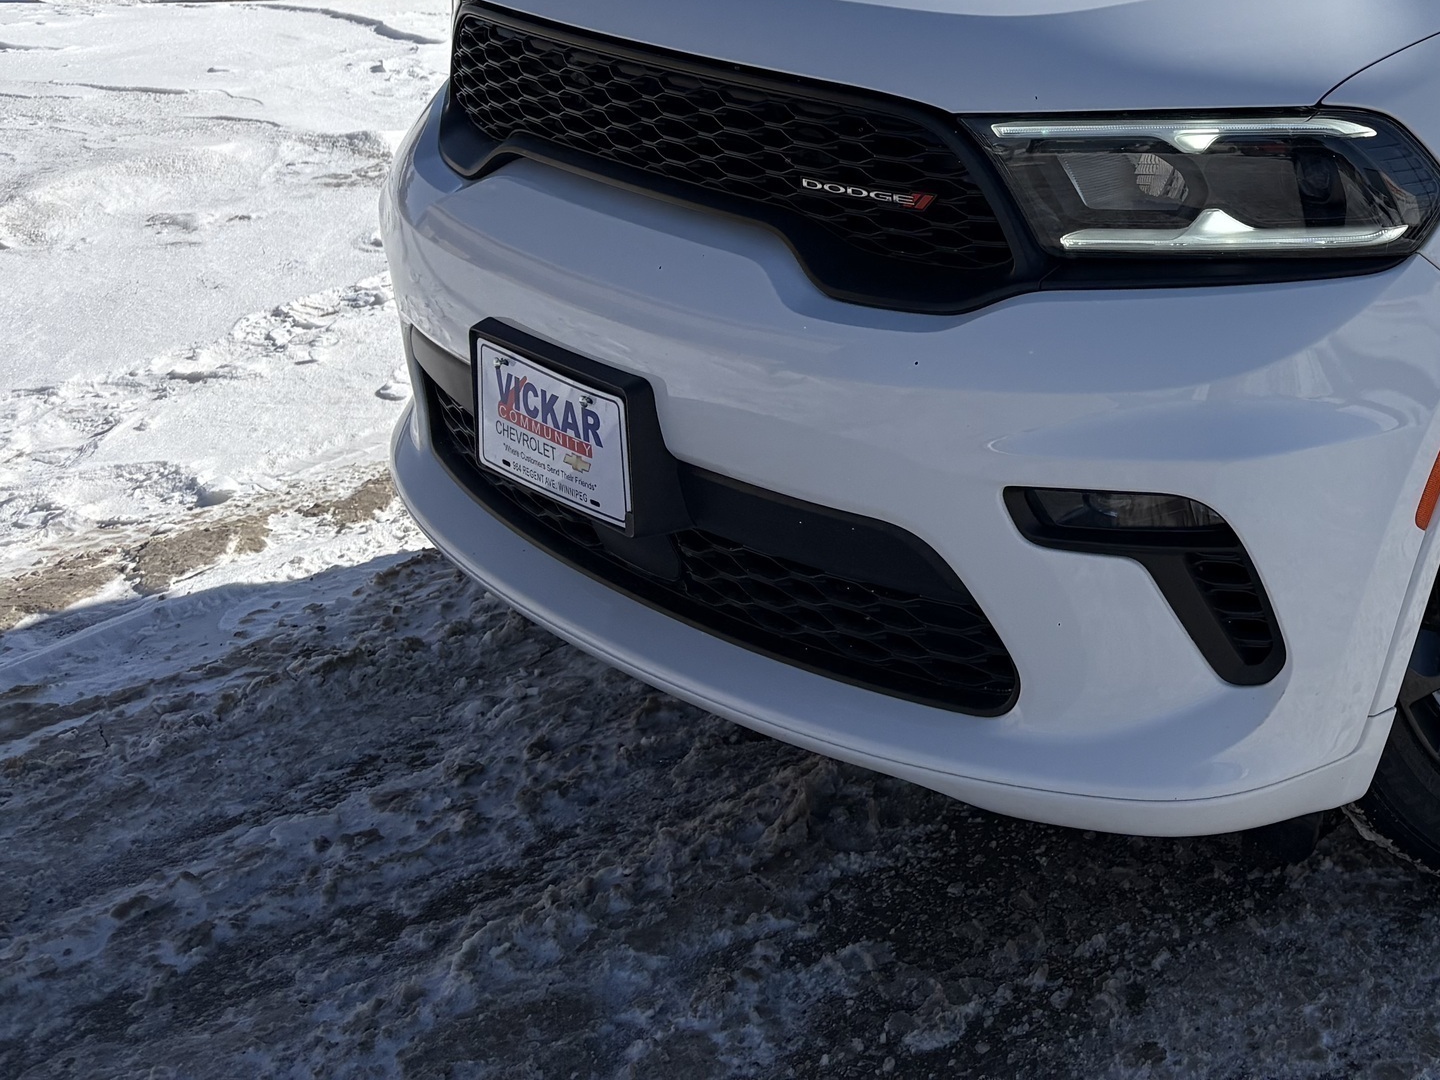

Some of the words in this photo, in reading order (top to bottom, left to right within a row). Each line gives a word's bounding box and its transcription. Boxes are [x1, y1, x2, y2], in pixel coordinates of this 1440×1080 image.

[802, 178, 915, 206] DODGE
[495, 367, 604, 449] VICKAR
[495, 419, 557, 461] CHEVROLET
[499, 405, 591, 457] COMMUNITY
[522, 465, 544, 484] REGENT
[557, 482, 588, 503] WINNIPEG
